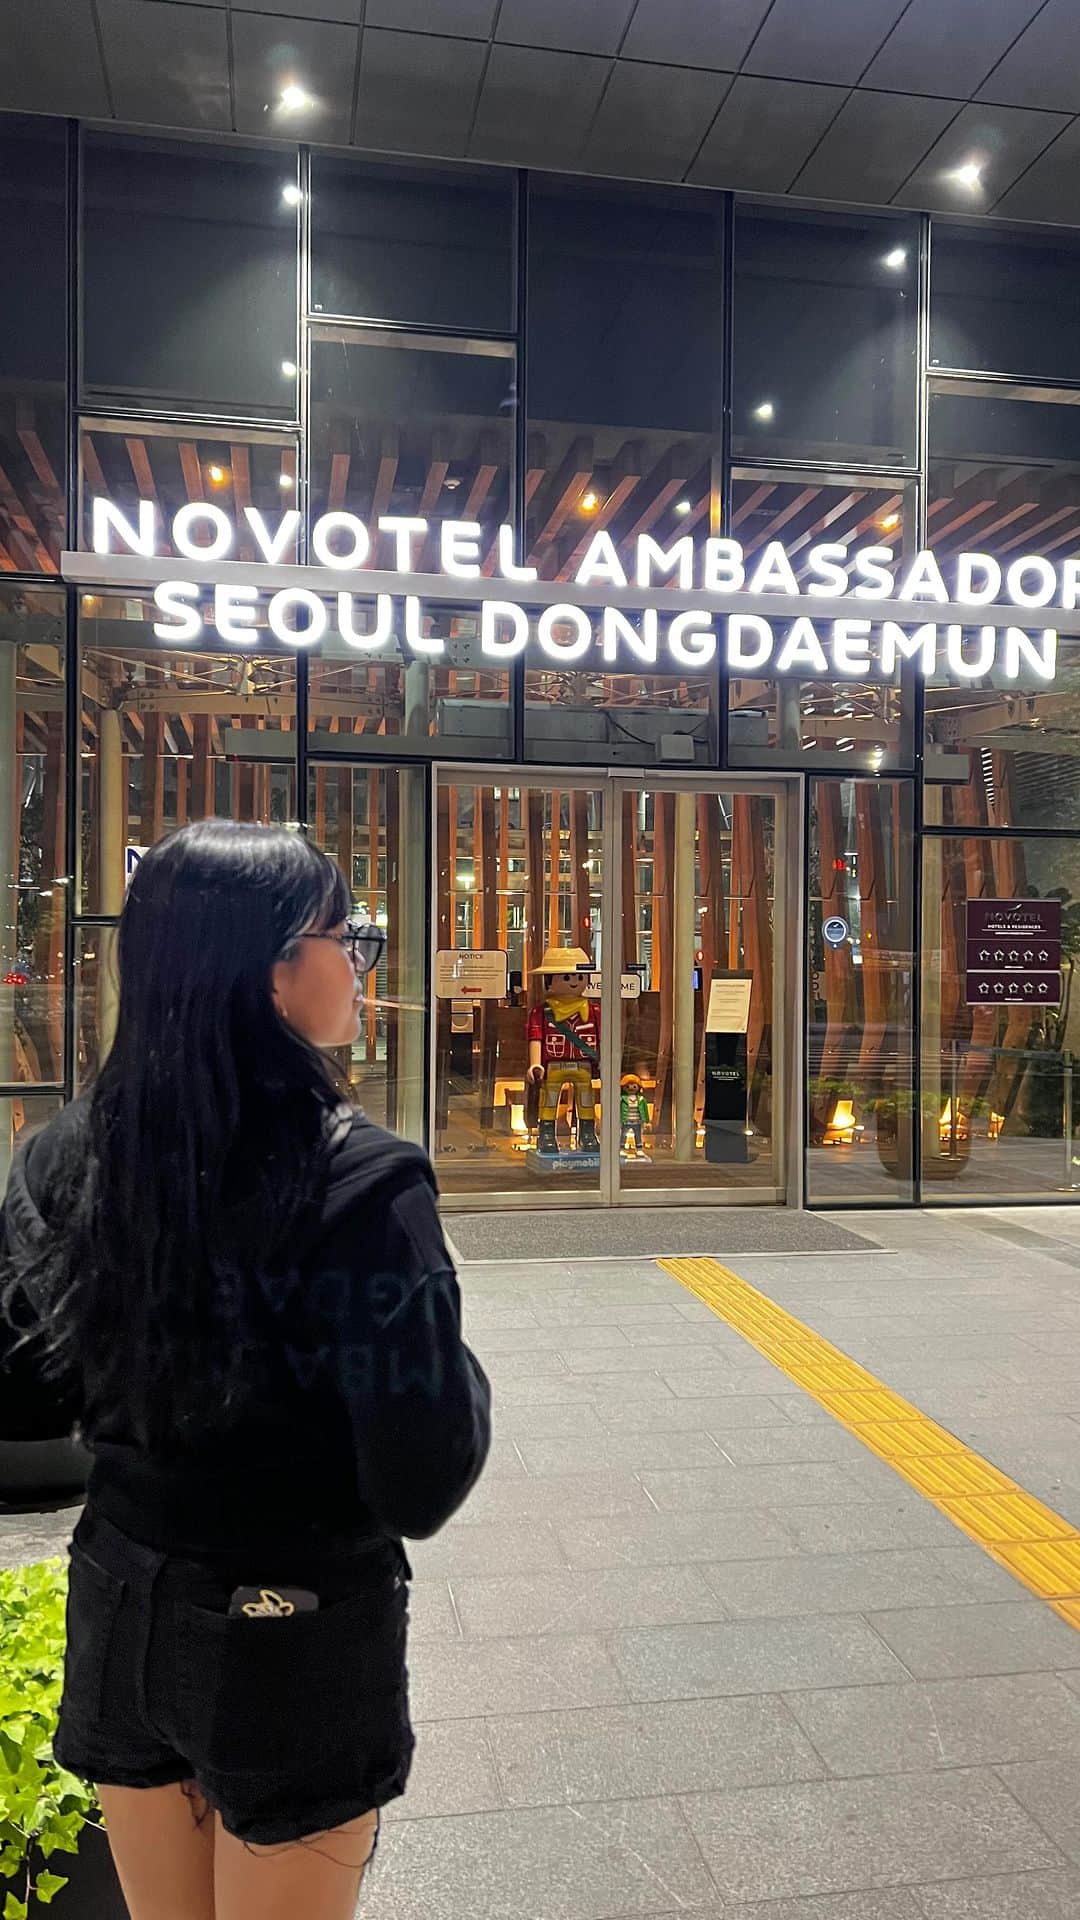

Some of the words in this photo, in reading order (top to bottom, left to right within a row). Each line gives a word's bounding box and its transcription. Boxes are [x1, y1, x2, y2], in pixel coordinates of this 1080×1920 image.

[93, 497, 538, 583] NOVOTEL
[154, 580, 445, 654] SEOUL
[481, 600, 1057, 680] DONGDAEMUN
[984, 911, 1043, 922] NOVOTEL
